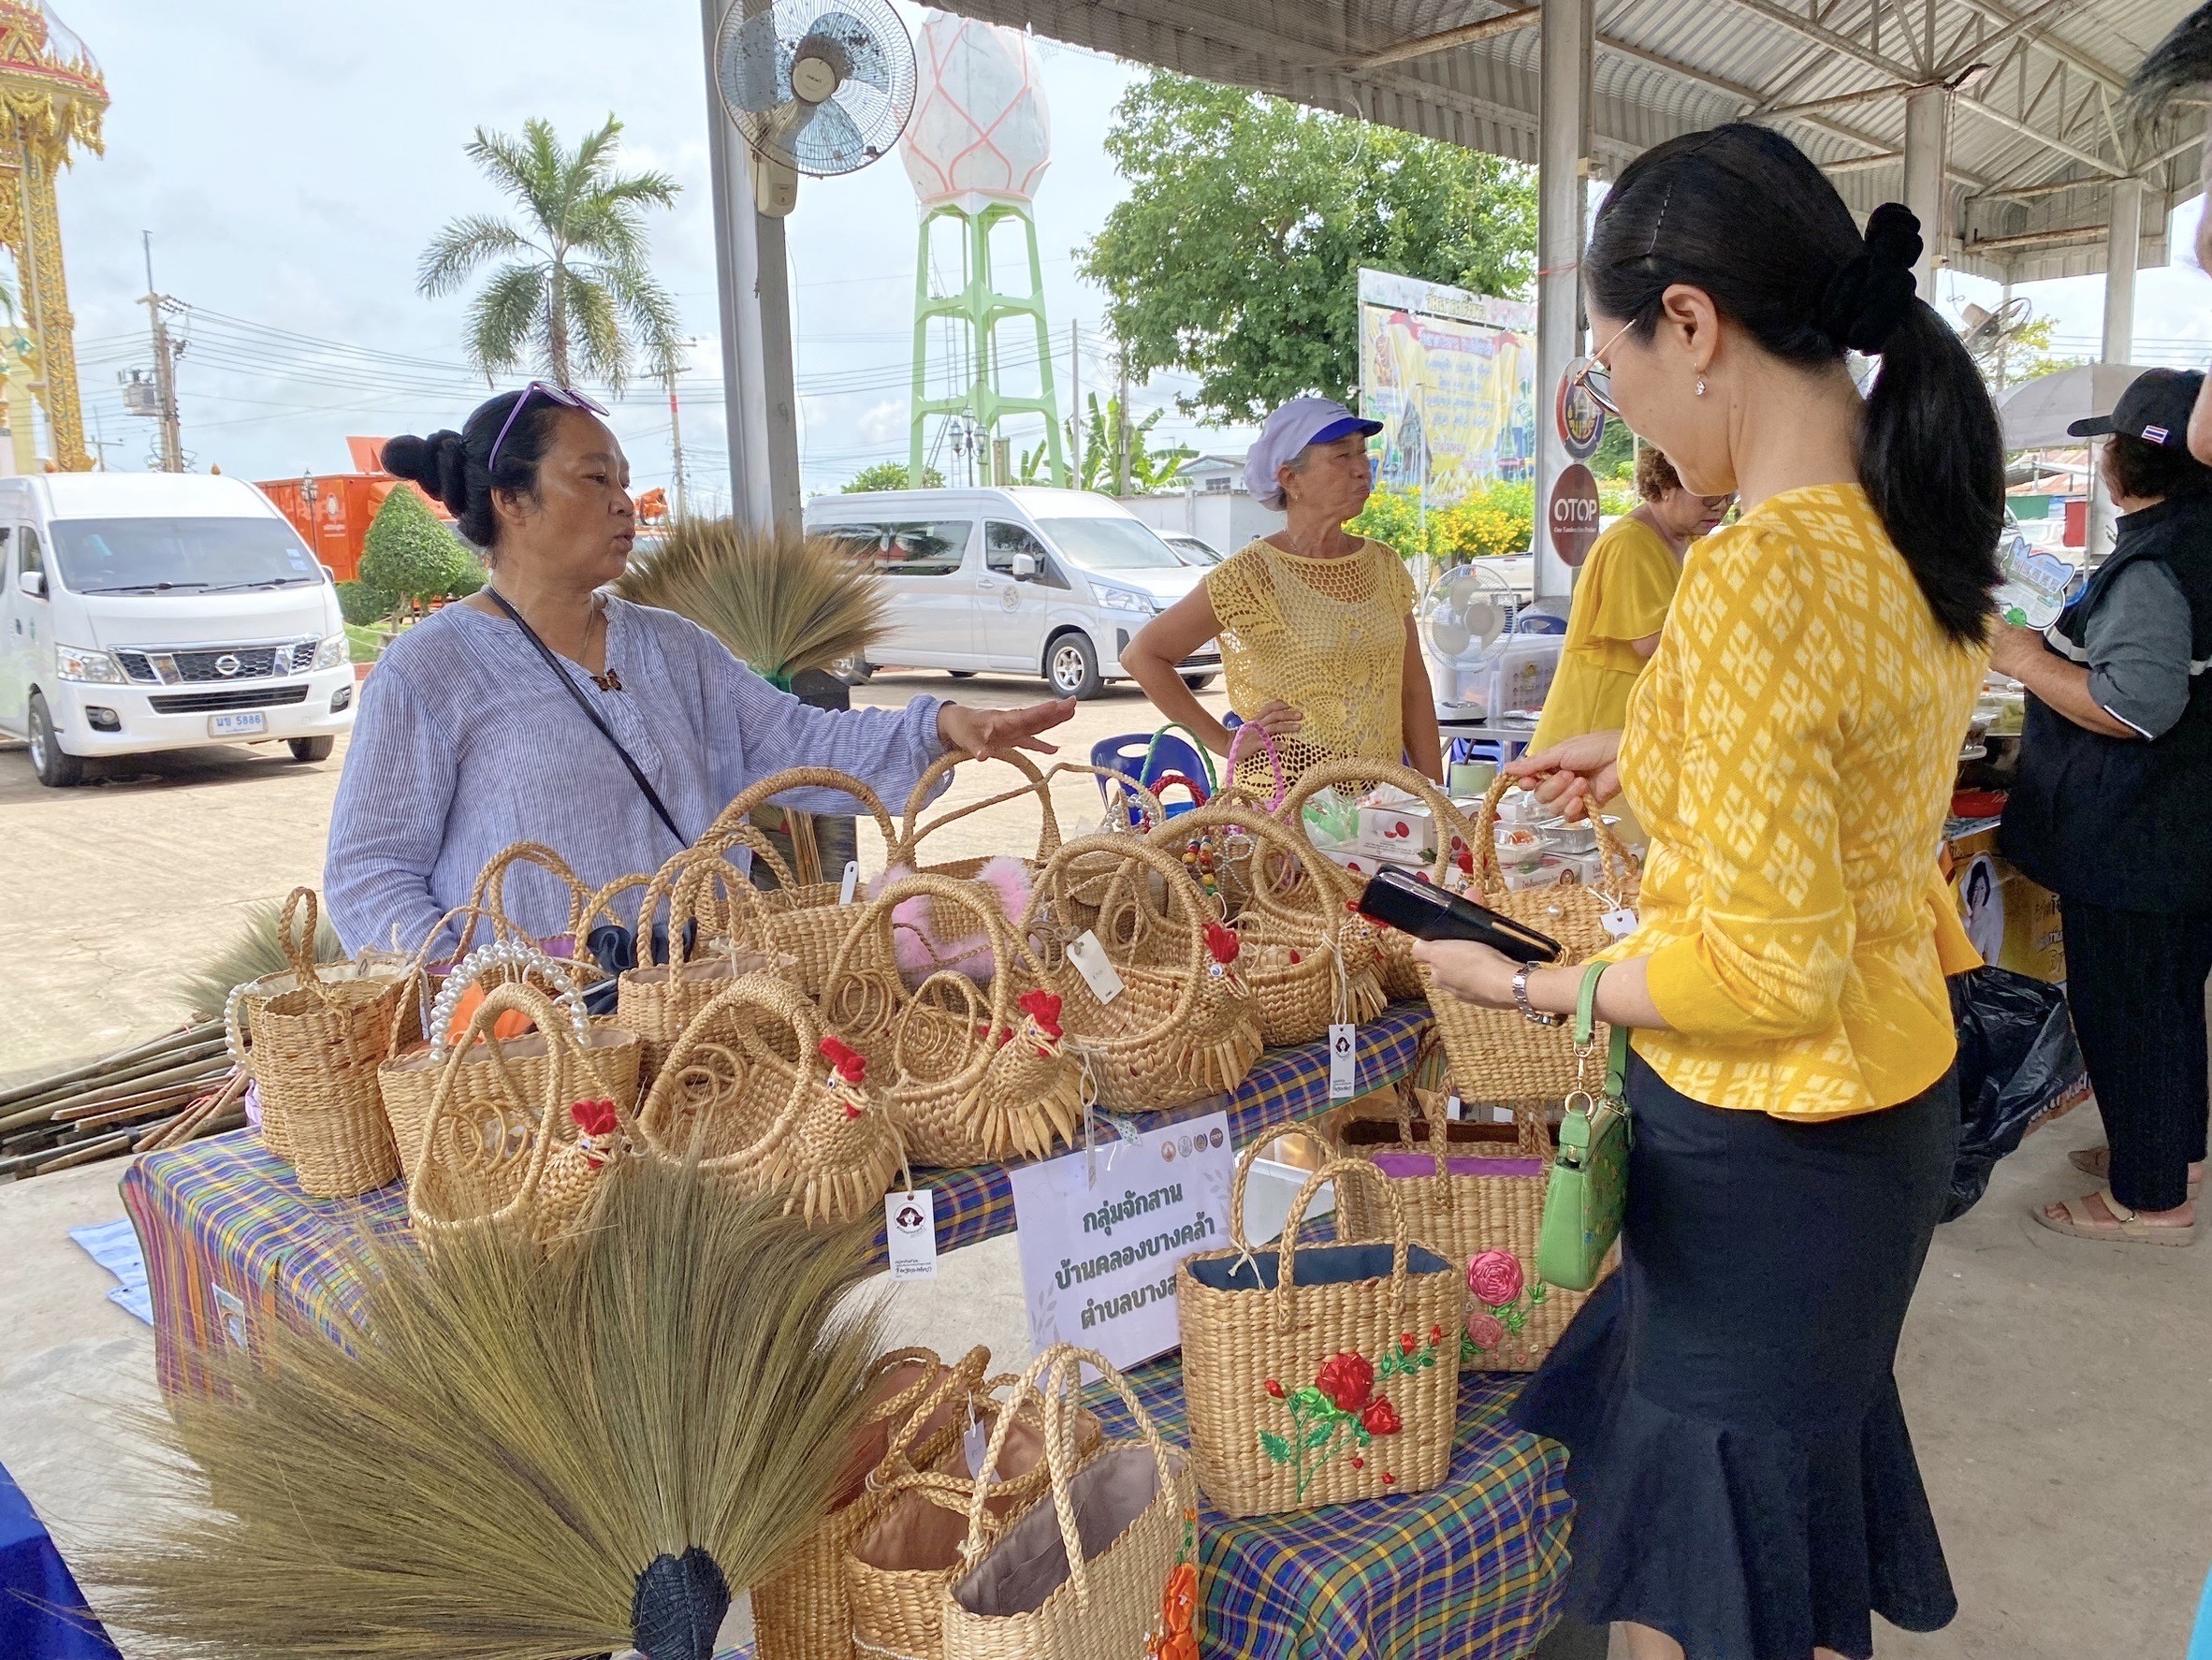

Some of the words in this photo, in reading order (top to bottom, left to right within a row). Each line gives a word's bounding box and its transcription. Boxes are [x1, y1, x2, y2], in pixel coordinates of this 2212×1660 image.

[1554, 498, 1597, 521] OTOP
[236, 715, 261, 725] 5886
[1083, 1183, 1184, 1236] กลุ่มจักสาน
[1055, 1212, 1215, 1289] บ้านคลองบางคล้า
